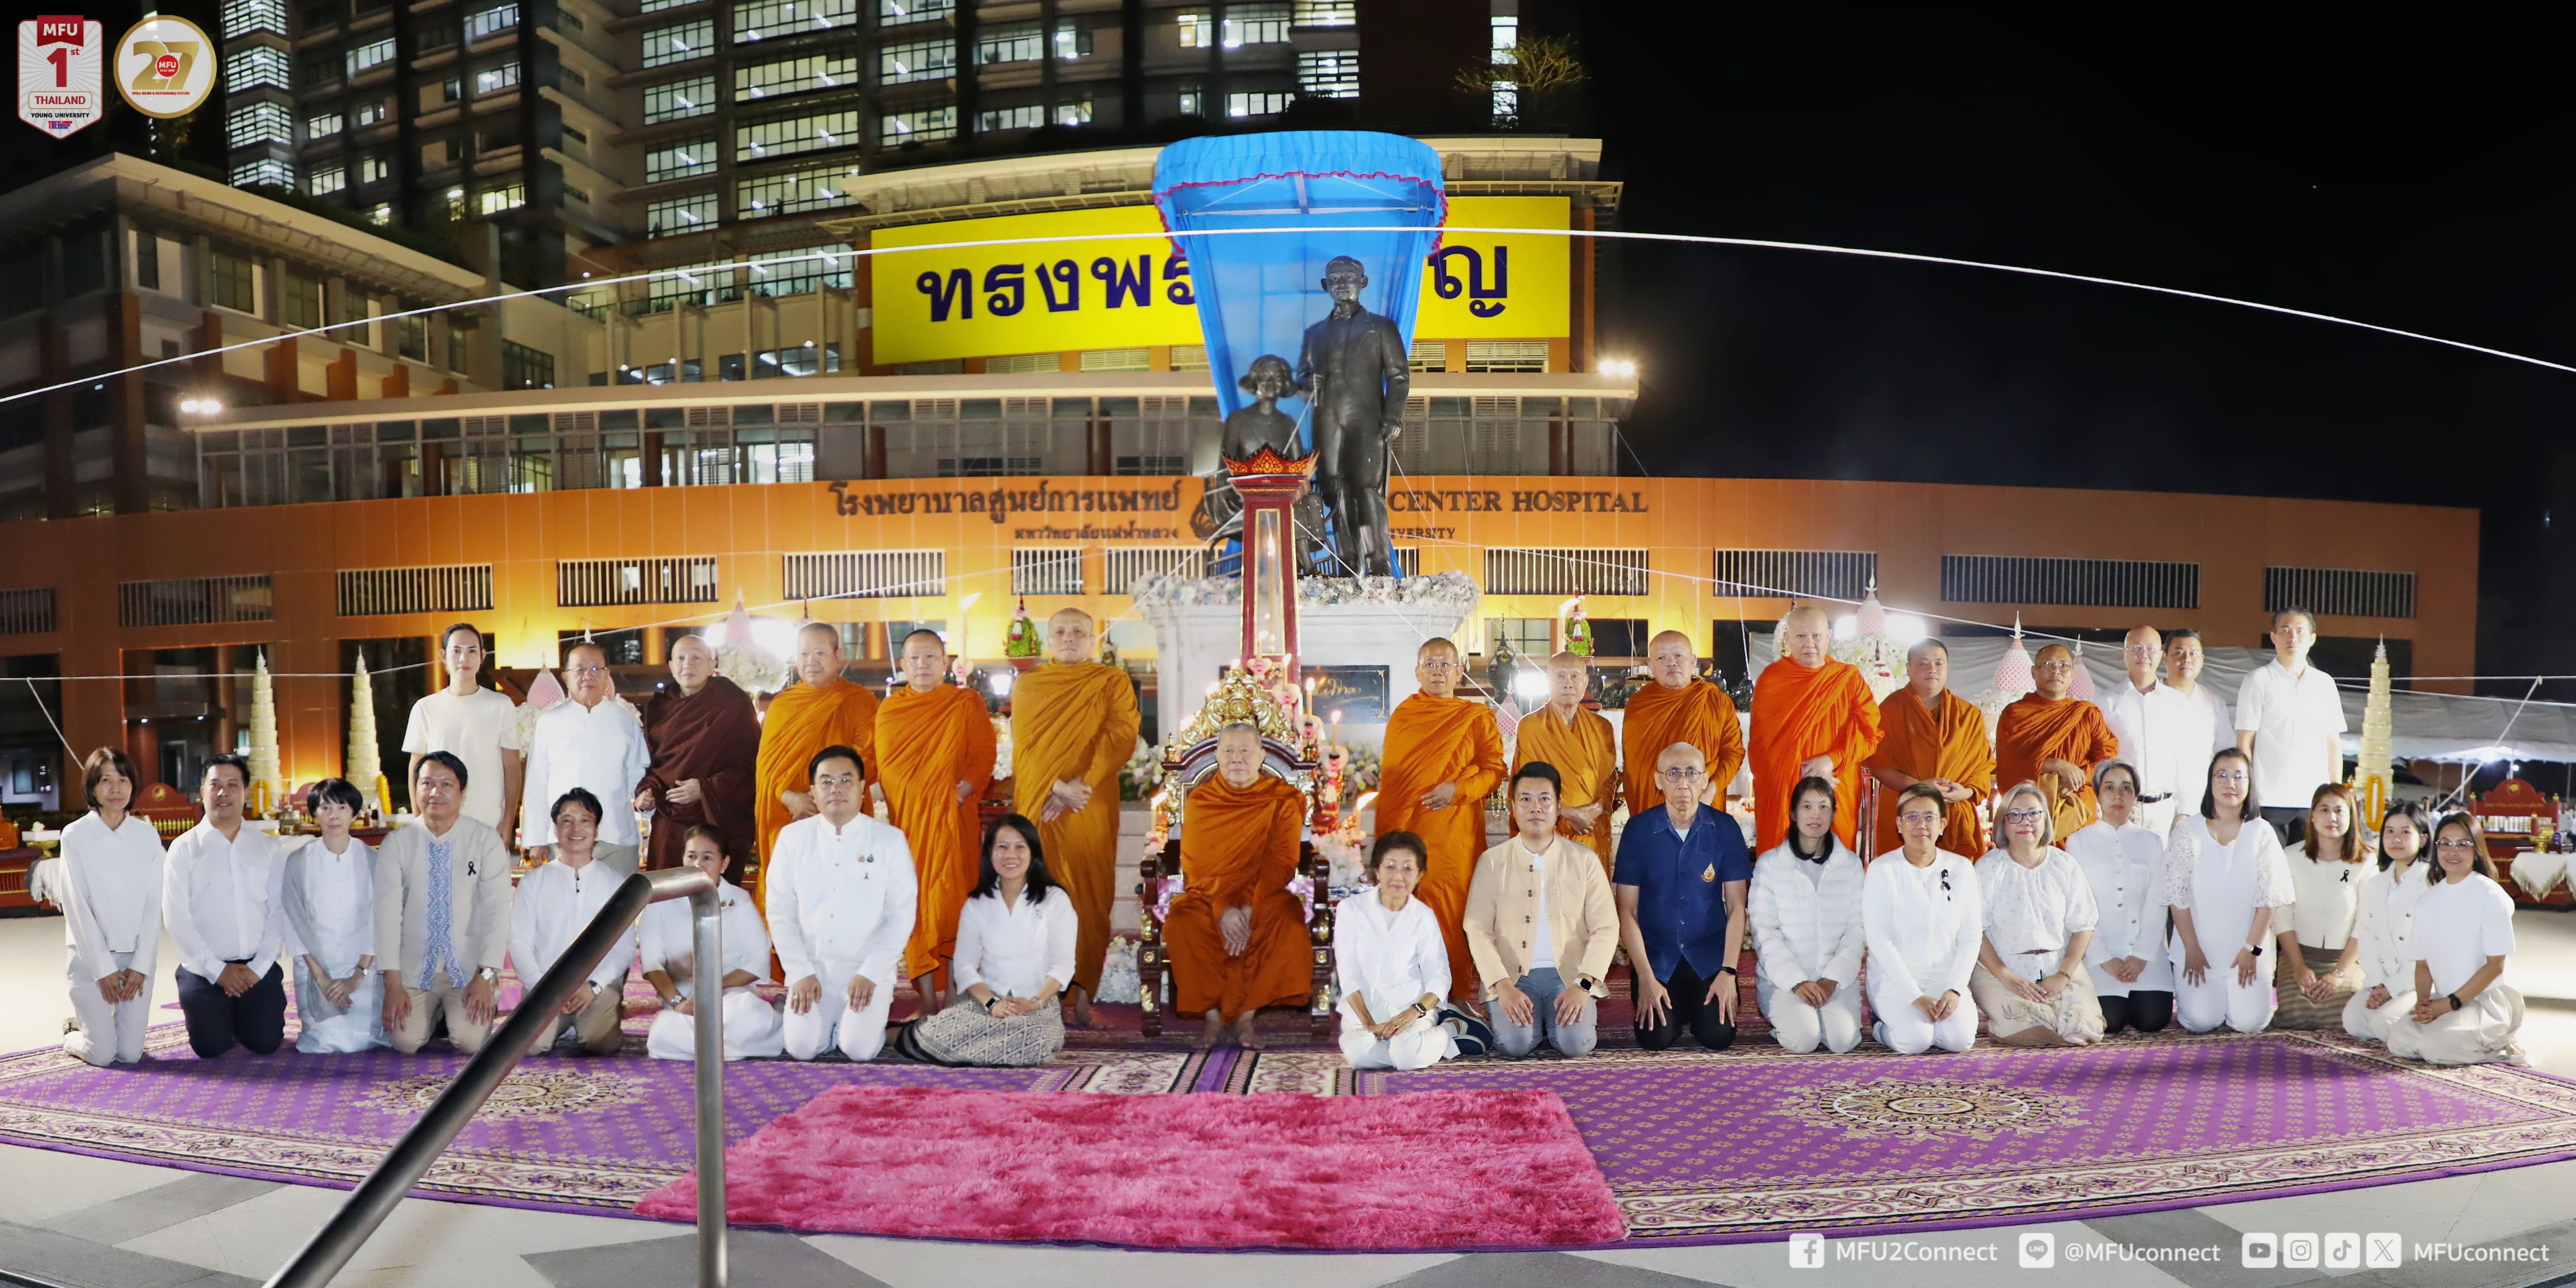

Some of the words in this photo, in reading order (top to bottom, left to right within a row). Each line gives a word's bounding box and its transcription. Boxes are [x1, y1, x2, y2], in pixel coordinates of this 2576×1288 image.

[829, 480, 1182, 524] โรงพยาบาลศูนย์การแพทย์
[1388, 490, 1503, 512] CENTER
[1512, 490, 1648, 513] HOSPITAL
